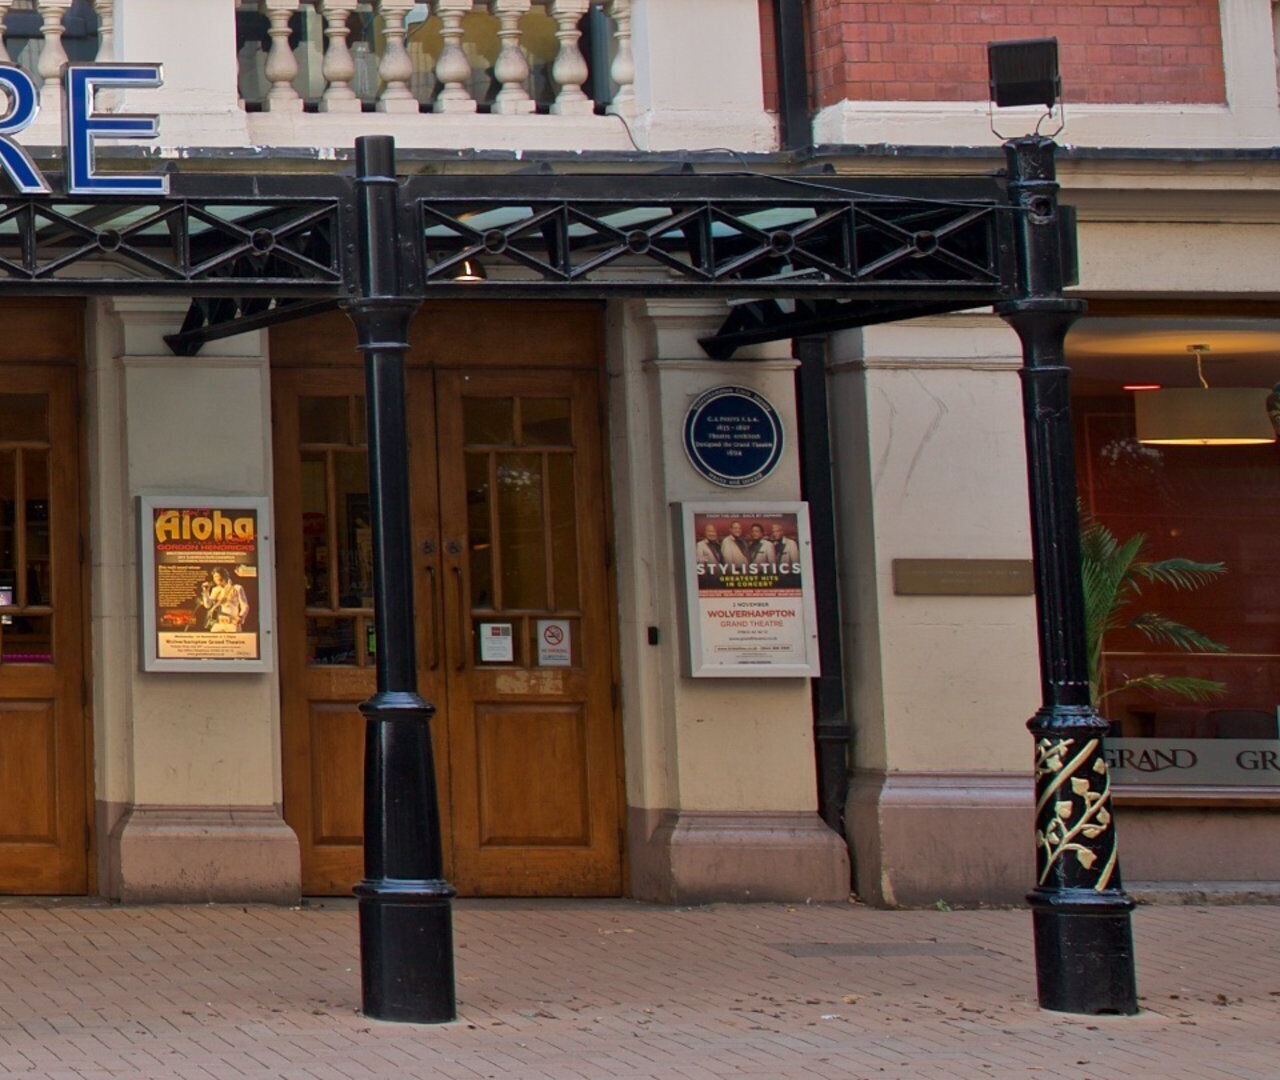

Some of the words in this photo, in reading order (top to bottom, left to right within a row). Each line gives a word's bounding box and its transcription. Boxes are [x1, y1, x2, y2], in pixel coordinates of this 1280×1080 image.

[155, 510, 254, 543] Aloha
[156, 543, 199, 551] GORDON
[696, 563, 801, 575] STYLISTICS
[707, 610, 796, 618] WOLVERHAMPTON
[1105, 748, 1198, 773] GRAND
